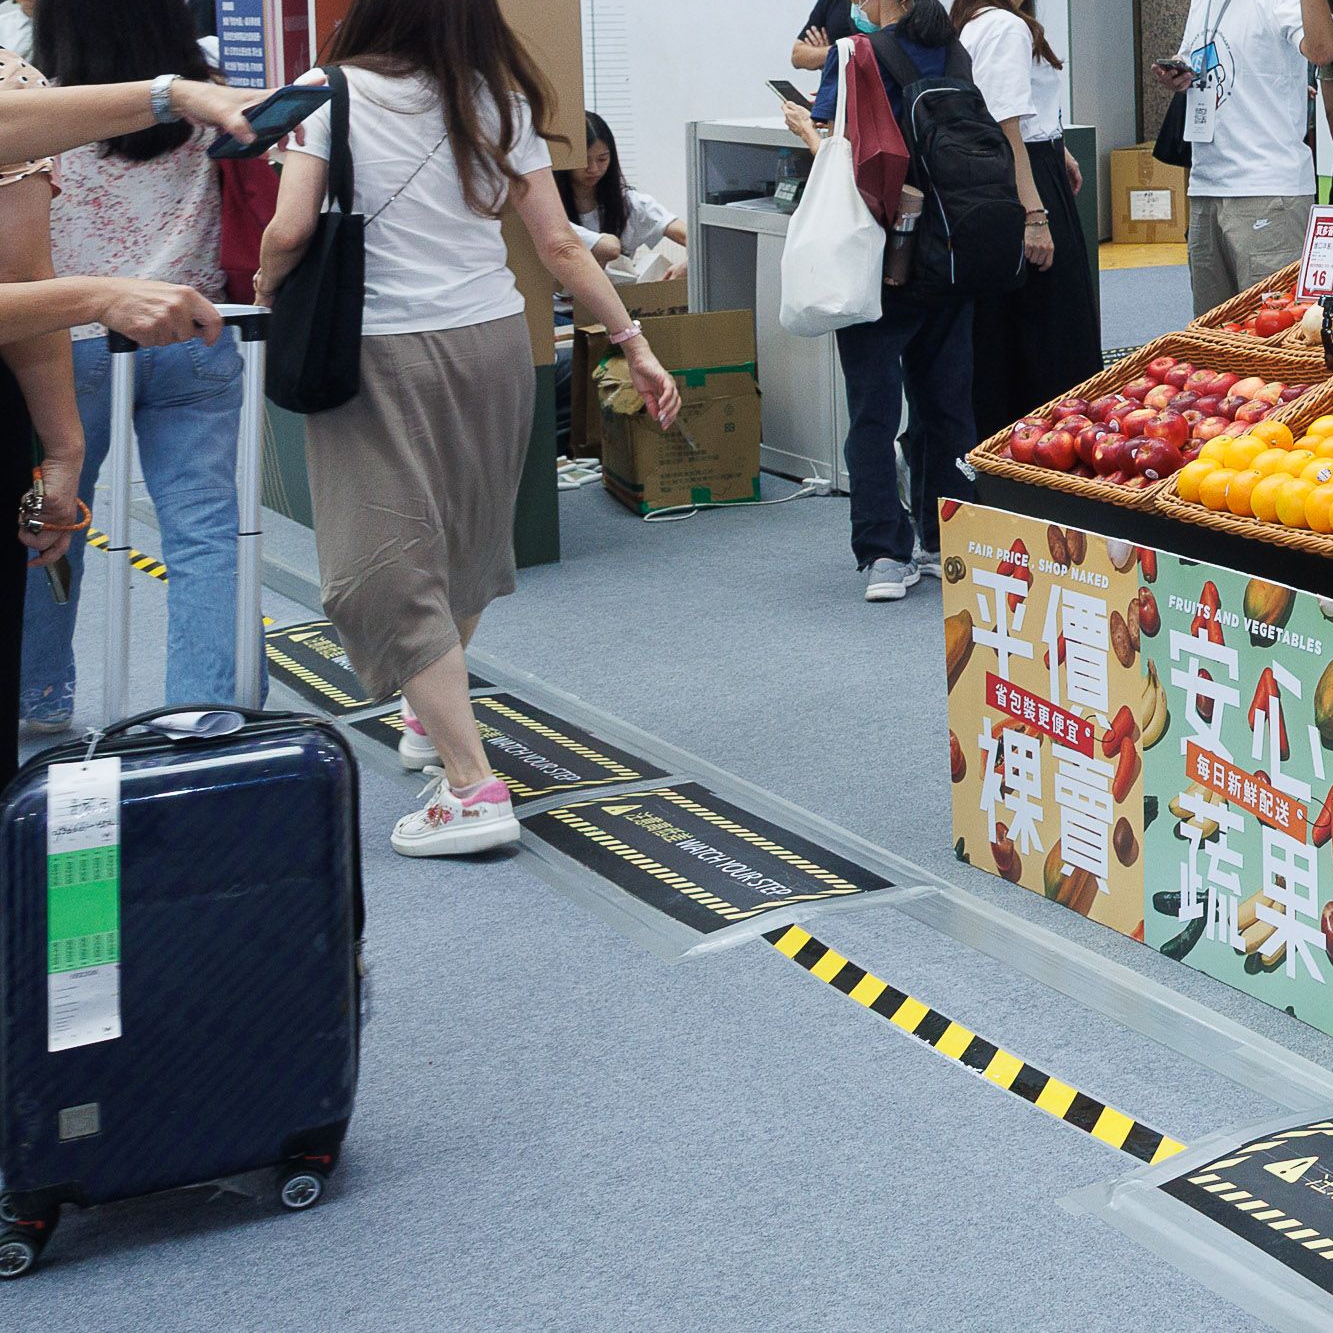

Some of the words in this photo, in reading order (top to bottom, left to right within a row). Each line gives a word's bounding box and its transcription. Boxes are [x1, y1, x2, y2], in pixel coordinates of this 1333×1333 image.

[1313, 270, 1326, 286] 16
[968, 541, 993, 559] FAIR
[996, 546, 1029, 568] PRICE
[1038, 559, 1068, 578] SHOP
[1071, 567, 1109, 590] NAKED
[1169, 594, 1211, 620] FRUITS
[1213, 605, 1240, 628] AND
[1243, 618, 1322, 655] VEGETABLES
[995, 682, 1079, 746] 省包裝更便宜
[1169, 627, 1325, 802] 安心
[978, 716, 1116, 895] 裸賣
[1196, 753, 1290, 827] 每日新鮮配送
[676, 838, 726, 868] WATCH
[721, 858, 760, 886] YOUR
[749, 878, 792, 896] STEP
[1178, 792, 1327, 984] 蔬果
